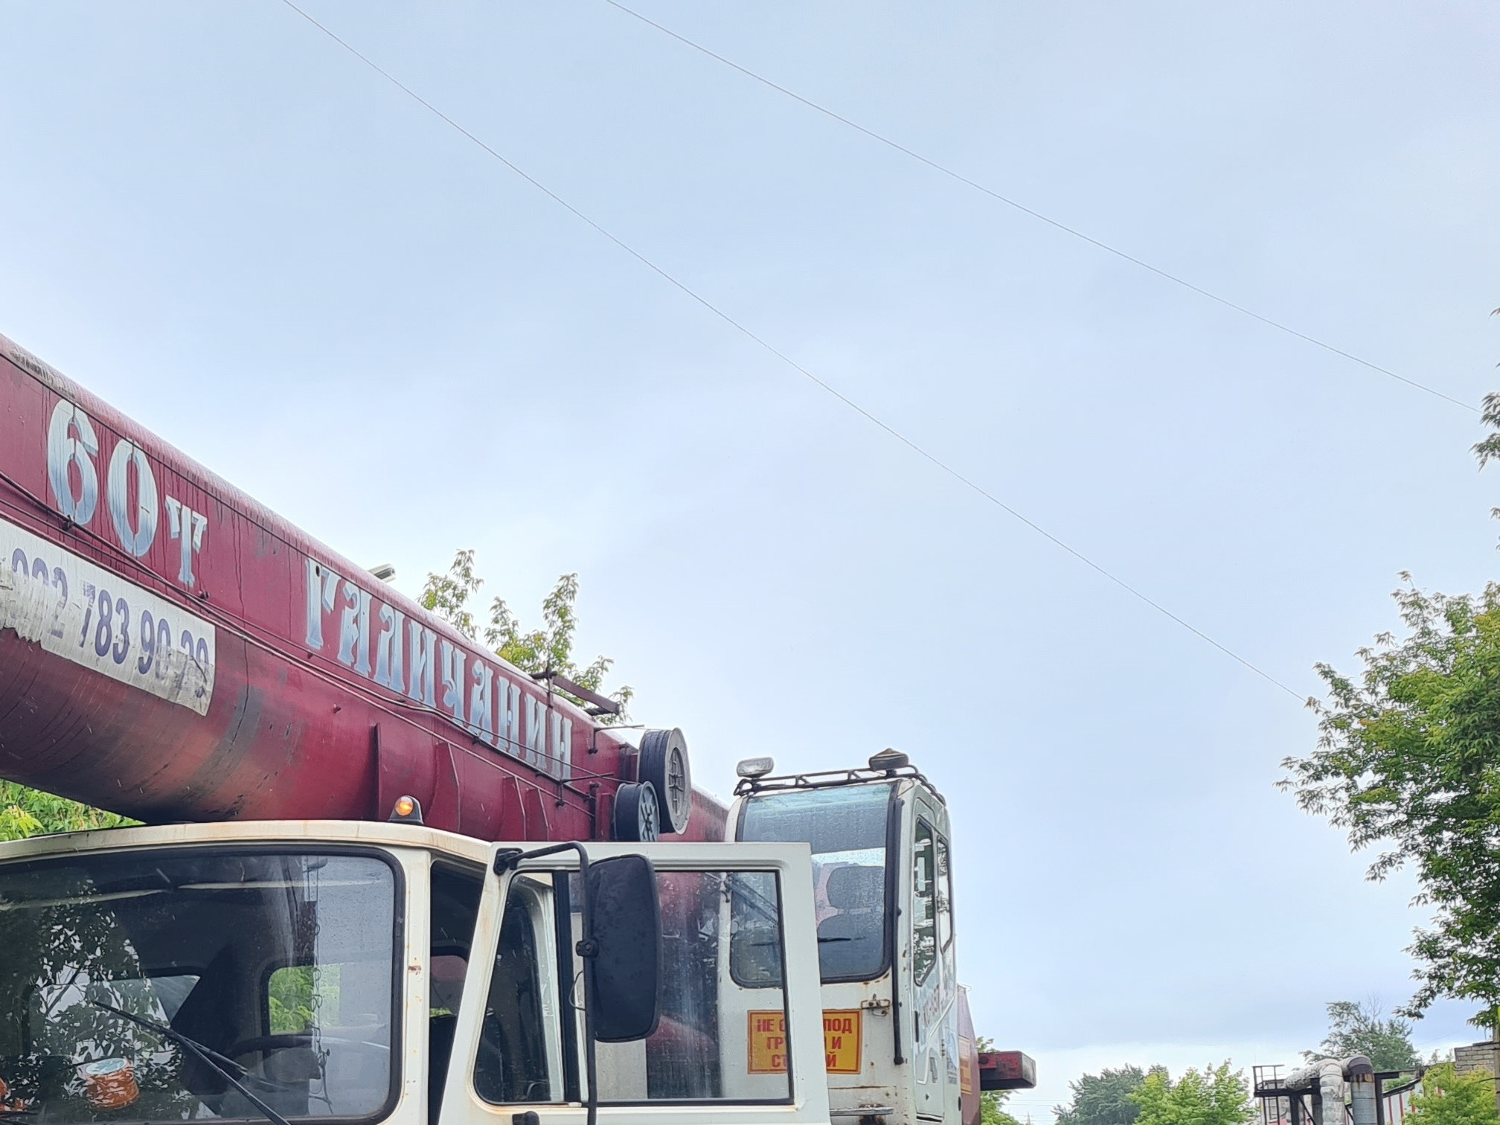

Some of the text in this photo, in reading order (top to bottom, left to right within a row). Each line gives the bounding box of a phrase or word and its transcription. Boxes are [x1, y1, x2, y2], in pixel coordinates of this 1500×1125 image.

[80, 579, 131, 665] 783
[756, 1018, 775, 1032] НЕ
[822, 1017, 853, 1034] ПОД
